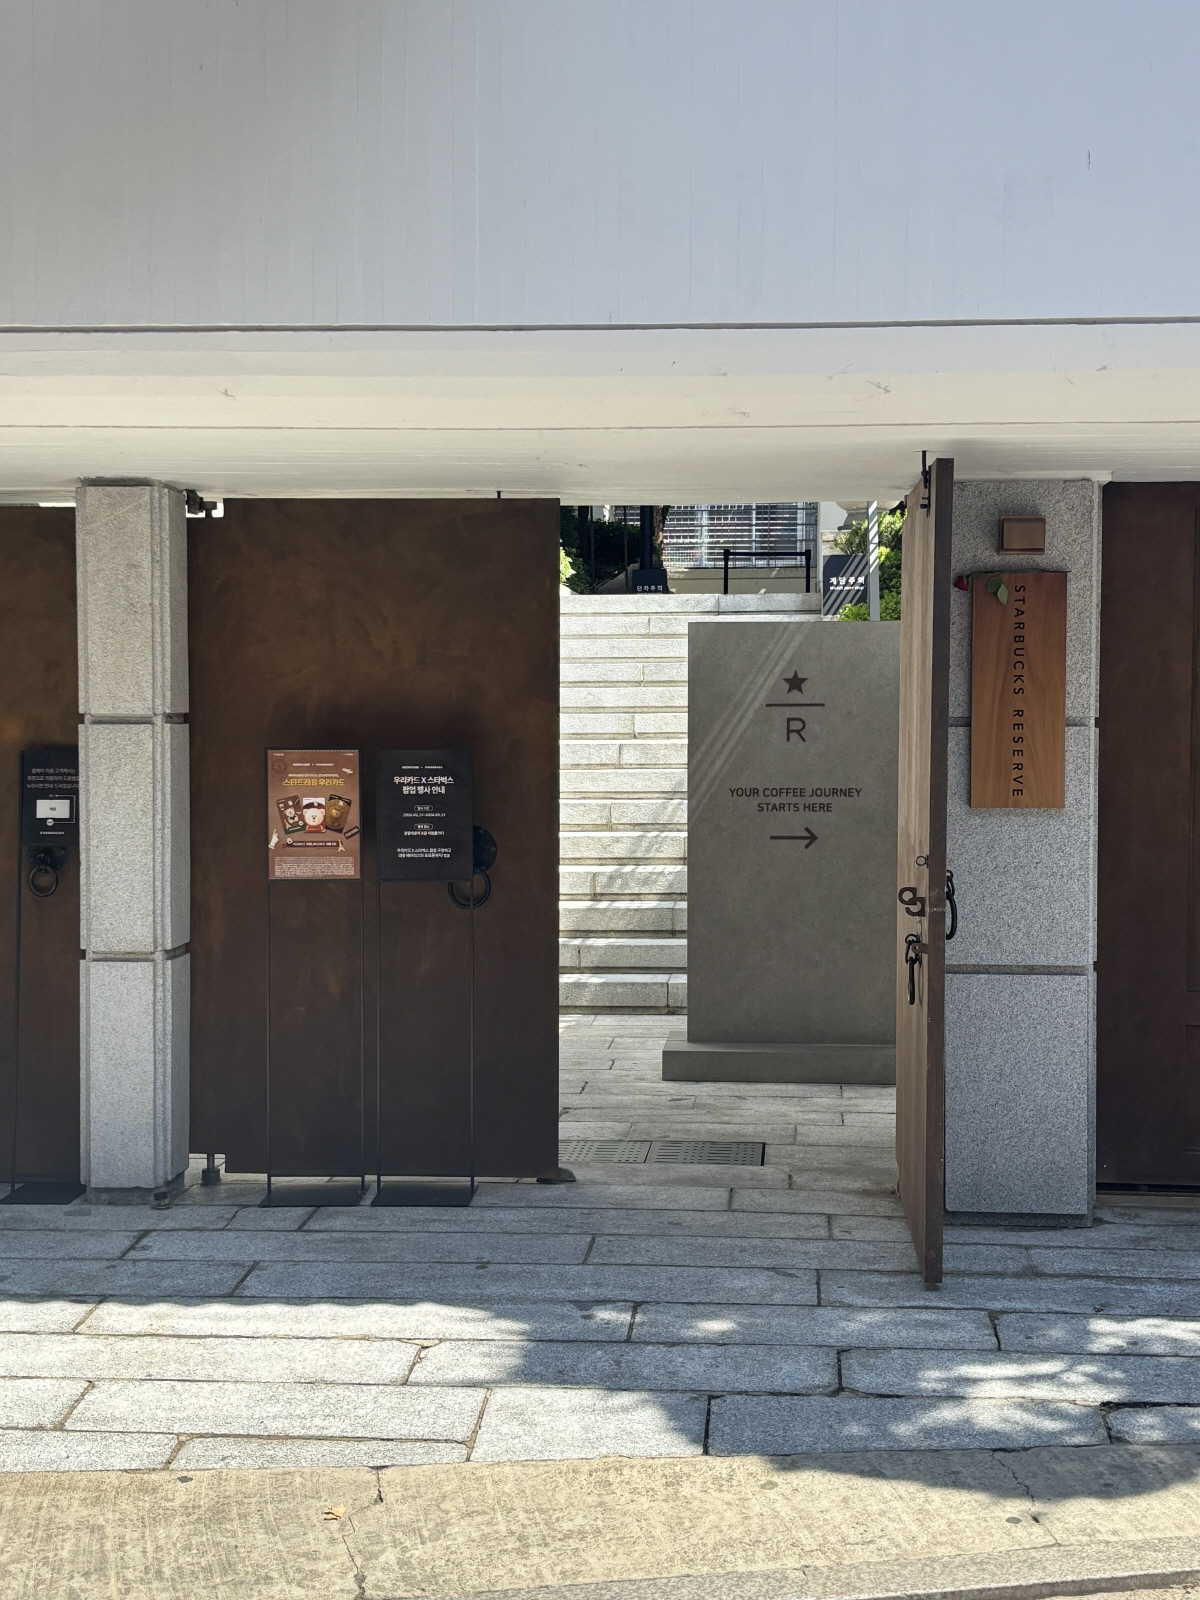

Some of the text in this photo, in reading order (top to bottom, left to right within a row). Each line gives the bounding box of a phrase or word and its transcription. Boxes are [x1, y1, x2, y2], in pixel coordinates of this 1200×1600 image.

[1012, 584, 1026, 798] STARBUCKS RESERVE
[786, 717, 807, 743] R
[393, 776, 420, 785] 우리카드
[427, 776, 455, 785] 스타벅스
[417, 786, 431, 795] 행사
[431, 786, 446, 795] 안내
[729, 787, 863, 798] YOUR COFFEE JOURNEY
[757, 802, 833, 812] STARTS HERE
